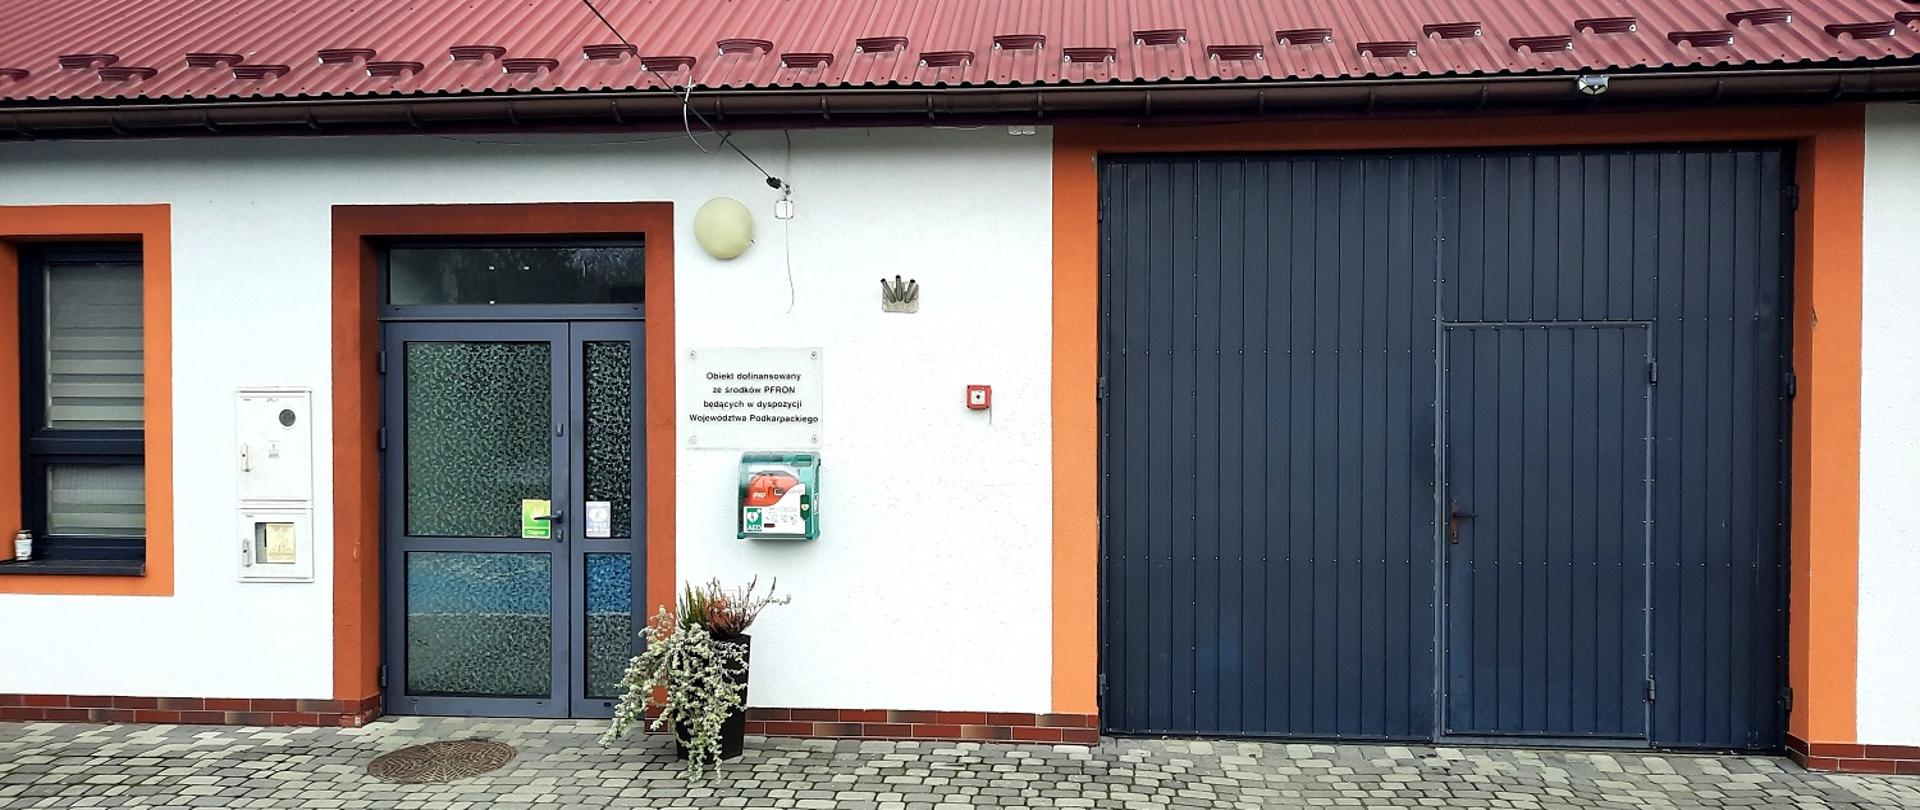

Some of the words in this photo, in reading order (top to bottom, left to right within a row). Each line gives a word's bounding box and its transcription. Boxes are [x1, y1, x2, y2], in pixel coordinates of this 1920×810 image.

[706, 371, 734, 380] Obiekt
[736, 372, 801, 381] dofinansowany
[725, 385, 761, 394] środków
[763, 386, 796, 394] PFRON
[703, 400, 744, 409] będących
[756, 400, 802, 409] dyspozycji
[749, 414, 819, 424] Podkarpackiego
